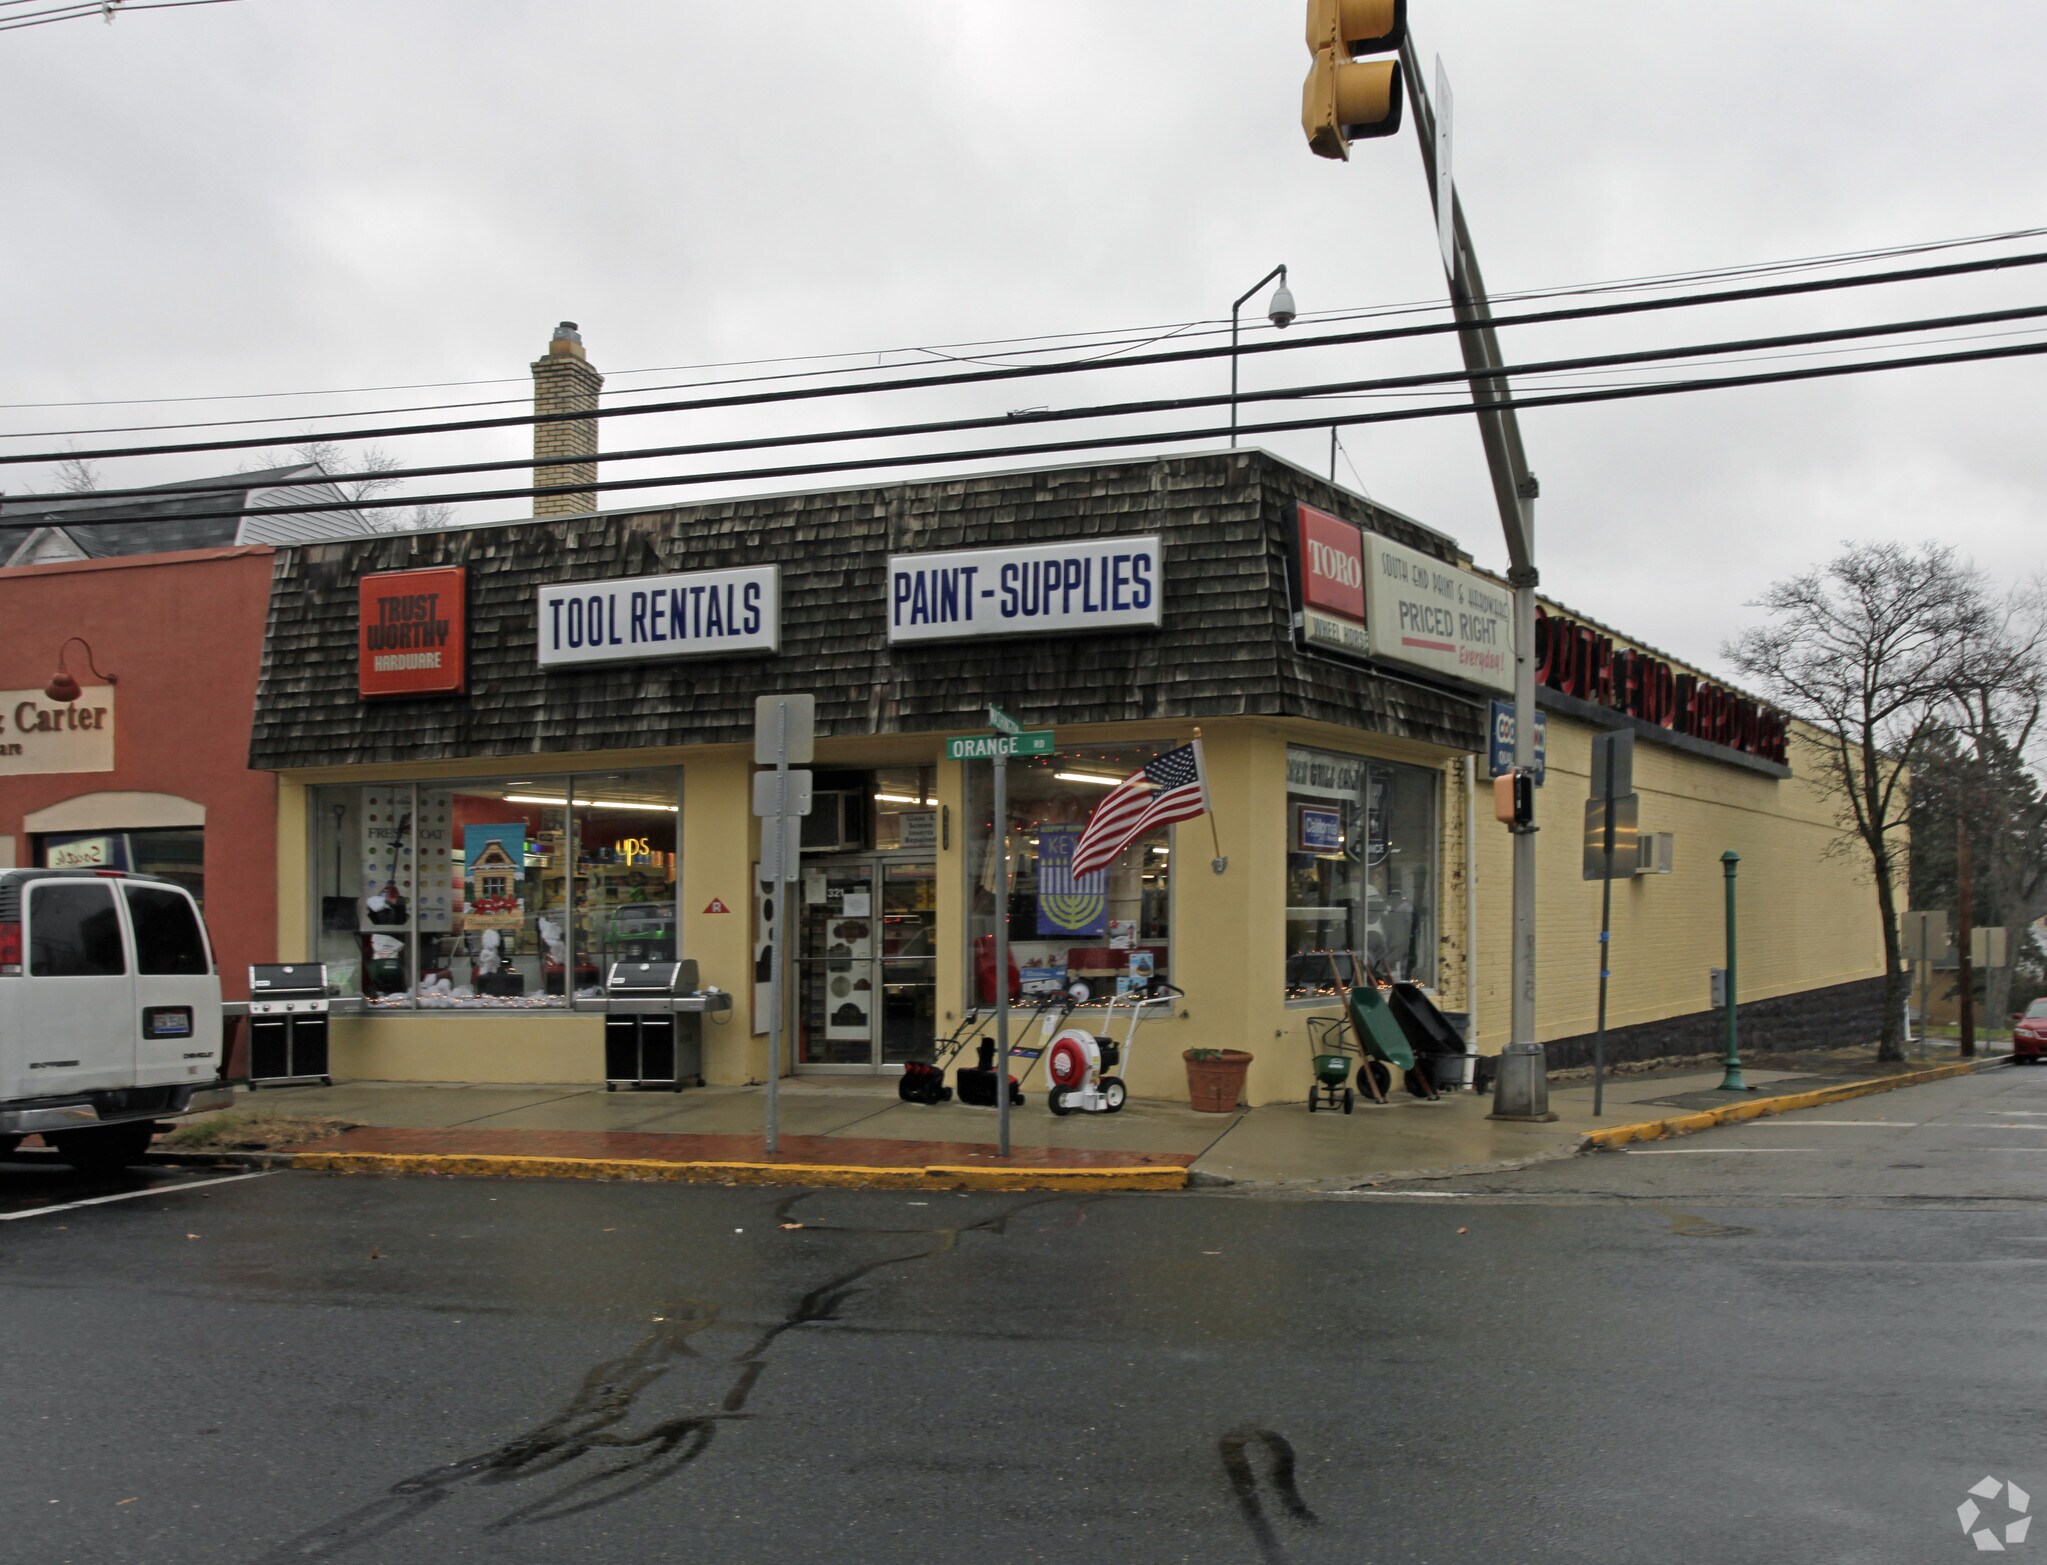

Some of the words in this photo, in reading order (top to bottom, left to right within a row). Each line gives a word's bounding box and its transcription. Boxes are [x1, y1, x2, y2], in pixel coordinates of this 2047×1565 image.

[1308, 539, 1361, 589] TORO
[1382, 552, 1408, 582] SOUTH
[1412, 565, 1429, 590] END
[1433, 572, 1454, 600] PAINT
[1469, 587, 1508, 622] HARDWARE
[377, 593, 439, 622] TRUST
[549, 594, 622, 649] TOOL
[631, 582, 761, 643] RENTALS
[367, 619, 449, 651] WORTHY
[1314, 617, 1340, 640] WHEEL
[1399, 600, 1454, 637] PRICED
[1459, 612, 1497, 645] RIGHT
[374, 651, 441, 672] HARDWARE
[1459, 645, 1504, 674] Everyday!
[1624, 647, 1676, 729] END
[15, 702, 107, 733] Carter
[953, 737, 1019, 757] ORANGE
[1033, 740, 1045, 749] RD
[368, 828, 399, 838] FRES
[1306, 817, 1338, 835] California
[615, 837, 650, 866] ups
[712, 902, 721, 912] R
[827, 888, 844, 898] 321
